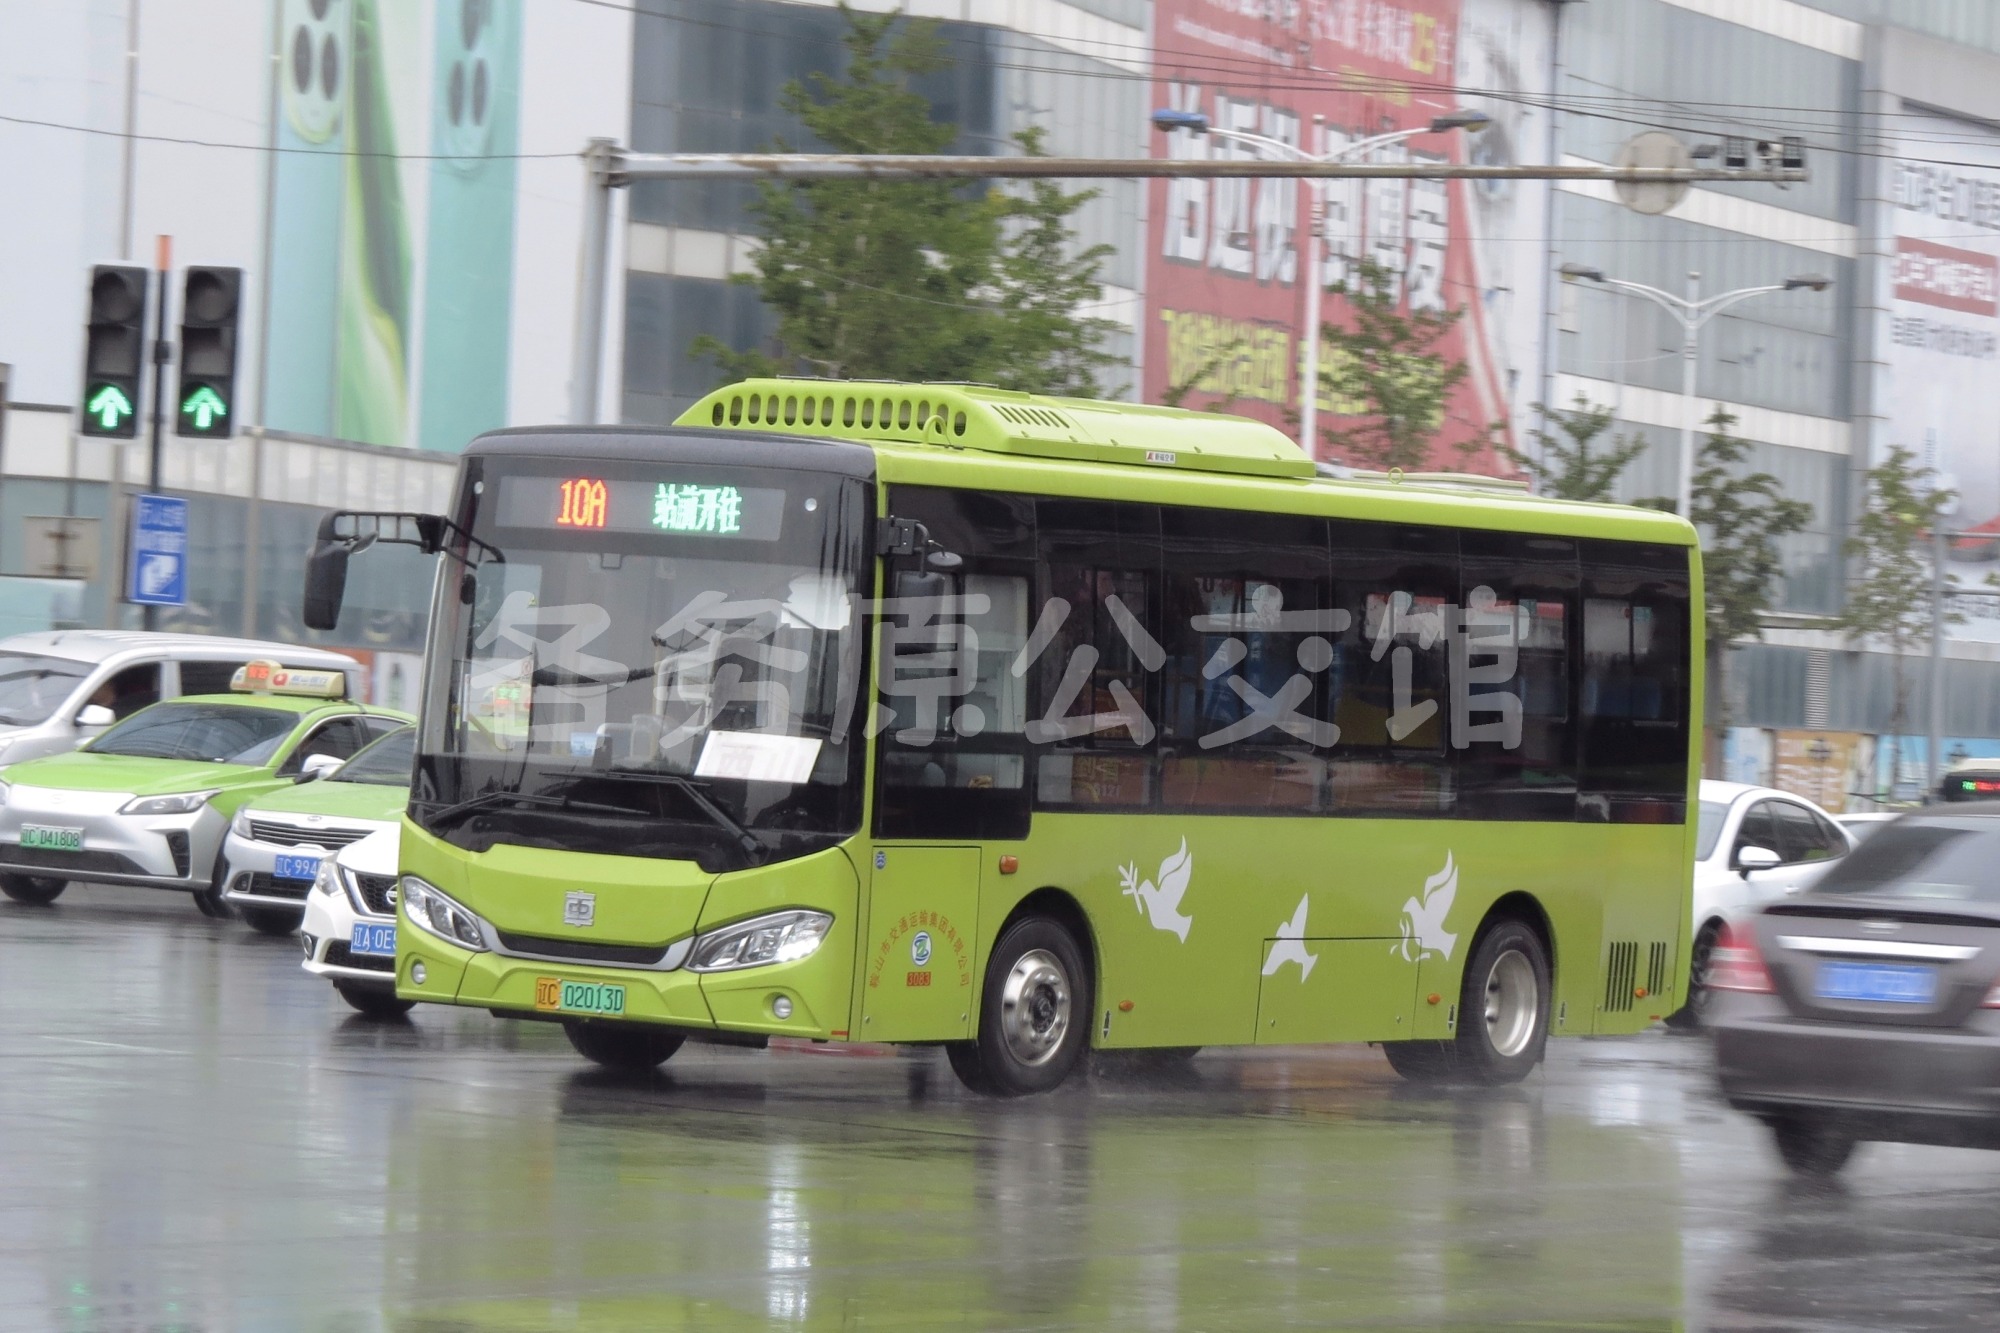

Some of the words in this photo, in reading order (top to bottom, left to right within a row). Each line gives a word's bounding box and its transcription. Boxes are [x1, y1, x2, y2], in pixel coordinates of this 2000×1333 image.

[557, 479, 606, 527] 10A
[652, 483, 742, 533] 站前开往
[40, 829, 80, 847] D41808
[908, 973, 930, 986] 3083
[538, 983, 558, 1006] 辽C
[564, 985, 624, 1011] 02013D
